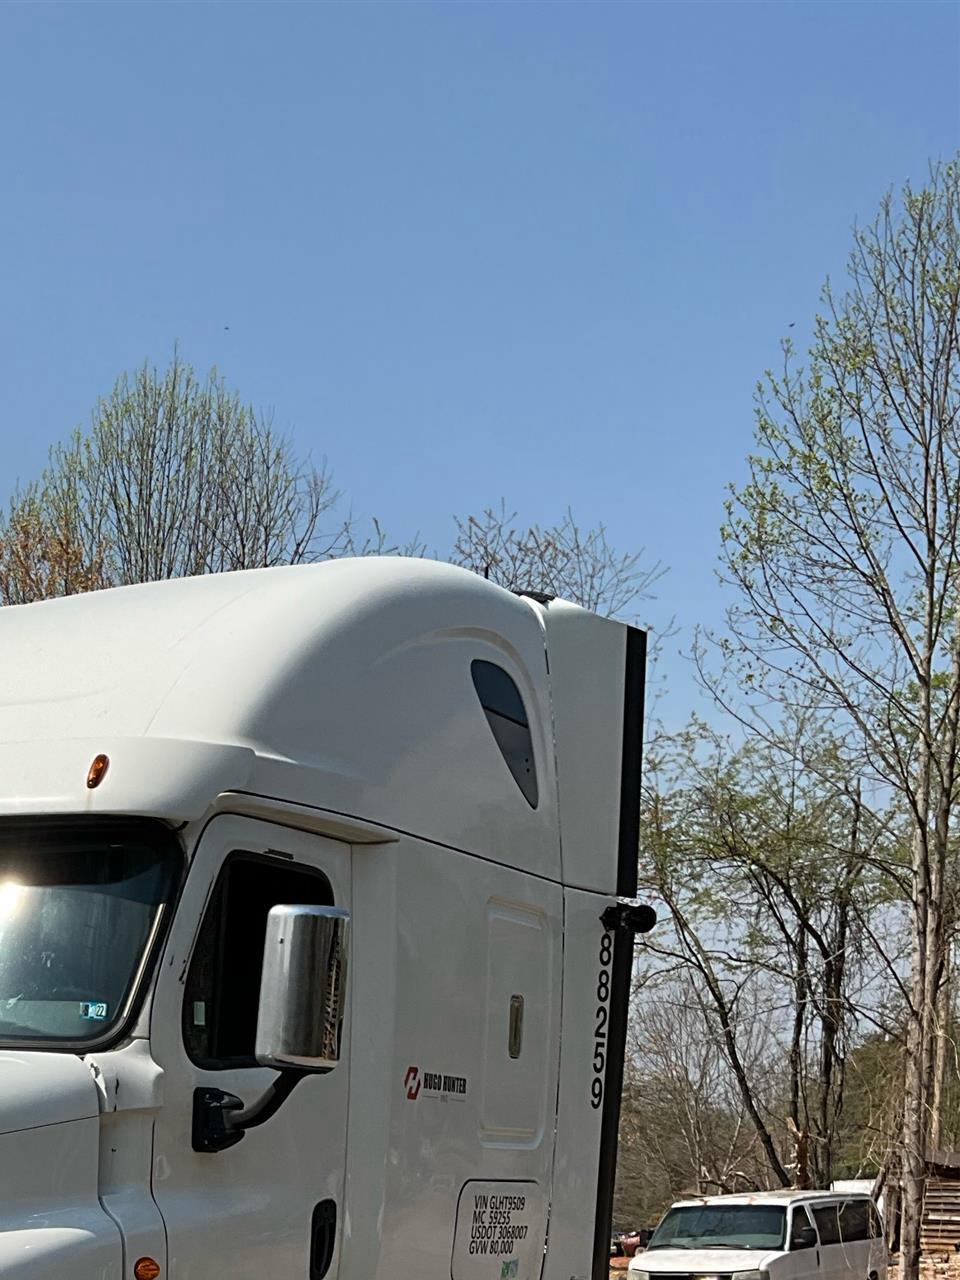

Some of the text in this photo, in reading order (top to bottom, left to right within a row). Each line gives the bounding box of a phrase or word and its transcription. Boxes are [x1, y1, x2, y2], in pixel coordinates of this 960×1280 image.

[591, 933, 612, 1109] 88259
[423, 1072, 467, 1094] HUGO HUNTER
[474, 1195, 525, 1211] VIN GLHT9509
[472, 1210, 511, 1225] MC 59255
[471, 1225, 528, 1240] USDOT 3068007
[469, 1240, 514, 1257] GVW 80,000
